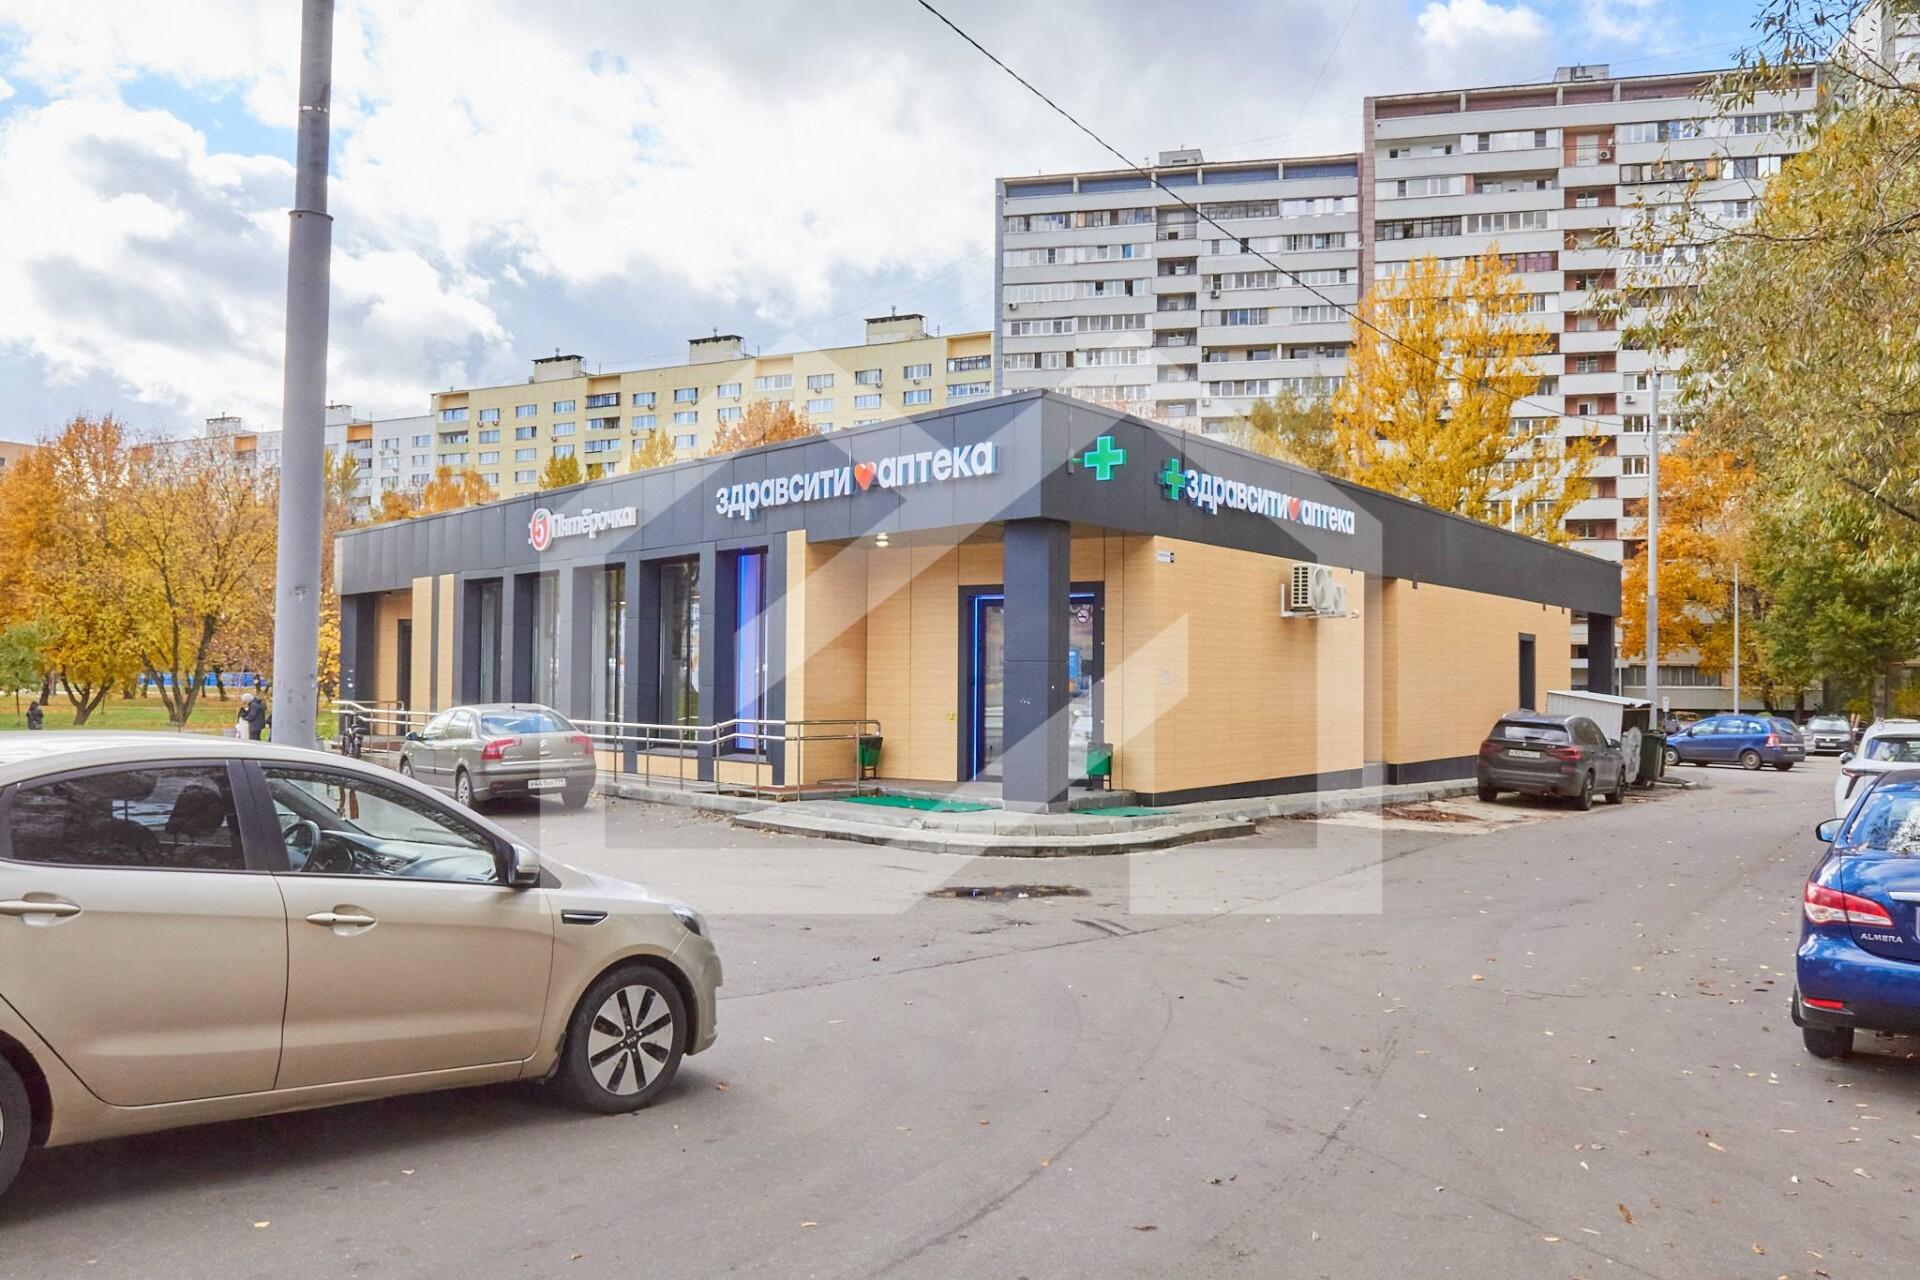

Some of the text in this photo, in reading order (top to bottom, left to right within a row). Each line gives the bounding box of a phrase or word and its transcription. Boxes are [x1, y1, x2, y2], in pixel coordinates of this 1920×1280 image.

[715, 441, 997, 520] здравсити аптека
[1186, 469, 1355, 535] здравсити аптека
[550, 506, 637, 539] Пятёрочка
[1860, 932, 1904, 944] ALMERA
